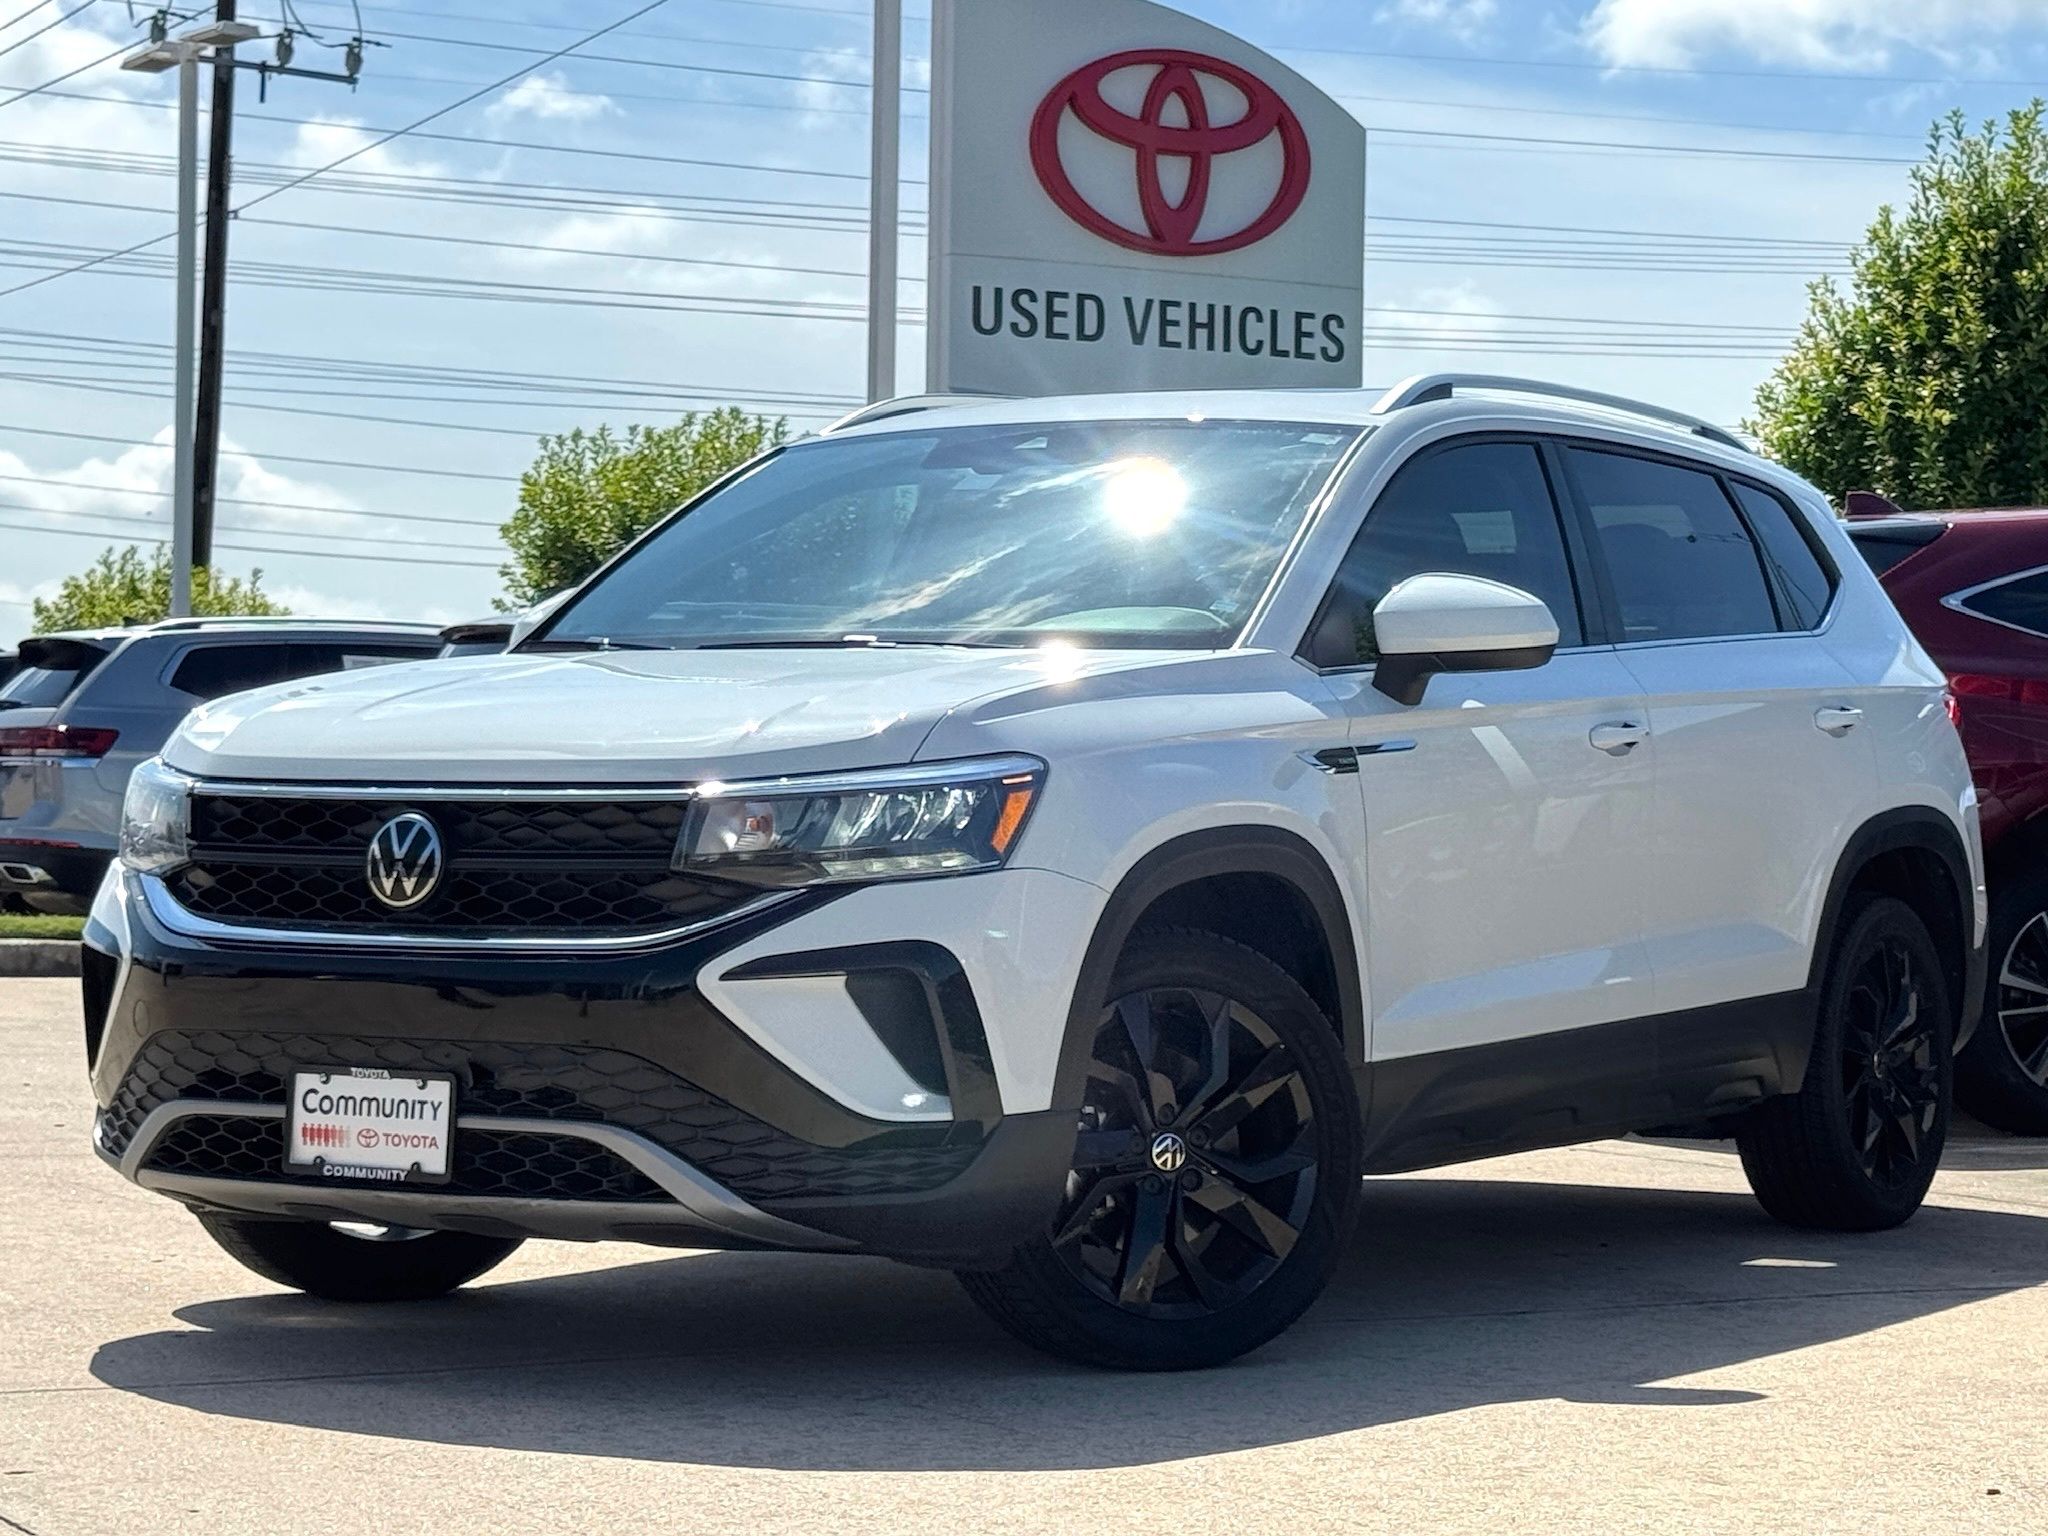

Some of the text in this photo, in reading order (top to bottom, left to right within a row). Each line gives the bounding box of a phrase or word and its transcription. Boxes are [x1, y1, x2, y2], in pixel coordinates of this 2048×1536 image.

[973, 286, 1346, 364] USED VEHICLES
[351, 1067, 391, 1080] TOYOTA
[382, 1132, 440, 1150] TOYOTA
[322, 1164, 409, 1181] COMMUNITY
